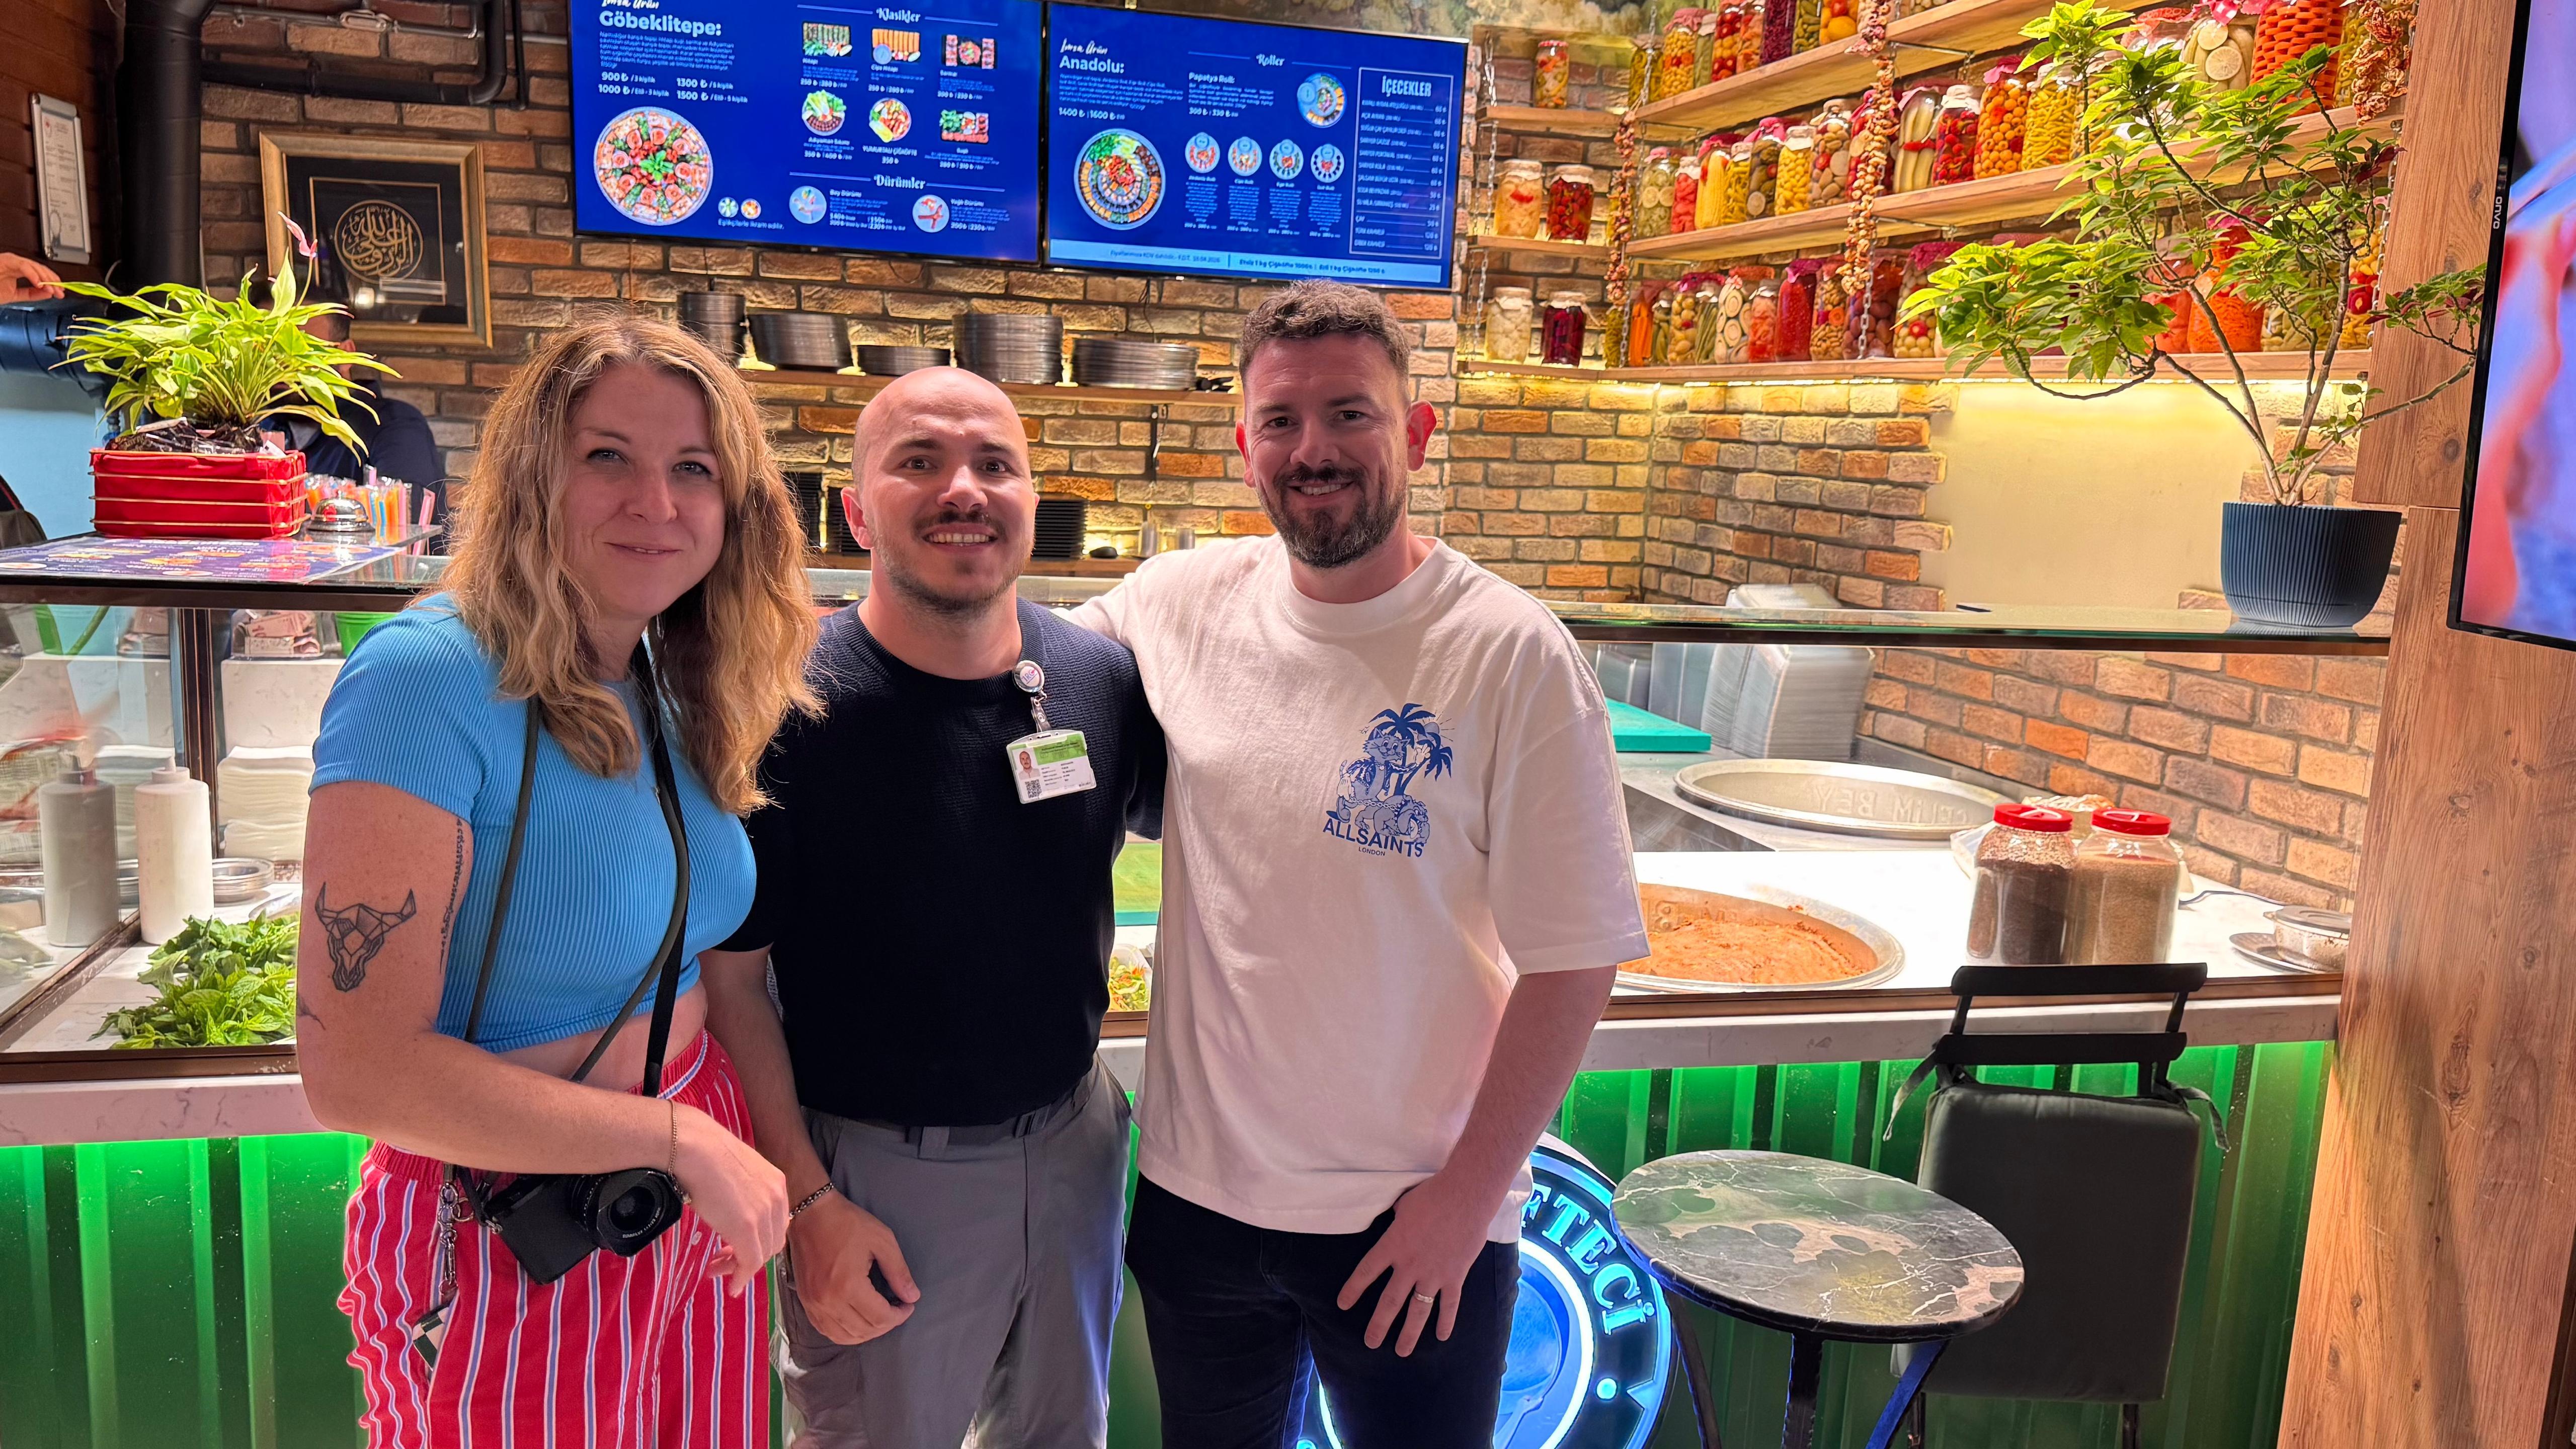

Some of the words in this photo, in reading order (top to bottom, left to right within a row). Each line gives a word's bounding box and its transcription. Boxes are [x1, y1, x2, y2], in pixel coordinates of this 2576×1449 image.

[876, 7, 921, 24] Klasikler
[599, 10, 721, 38] Göbeklitepe:
[1059, 55, 1124, 73] Anadolu:
[1256, 53, 1285, 66] Roller
[601, 71, 620, 81] 900
[677, 77, 698, 88] 1300
[598, 84, 621, 94] 1000
[1382, 75, 1432, 97] İÇECEKLER
[677, 90, 698, 101] 1500
[1059, 107, 1078, 116] 1400
[873, 174, 926, 189] Dürümler
[1323, 818, 1424, 858] ALLSAINTS
[1358, 846, 1386, 857] LONDON
